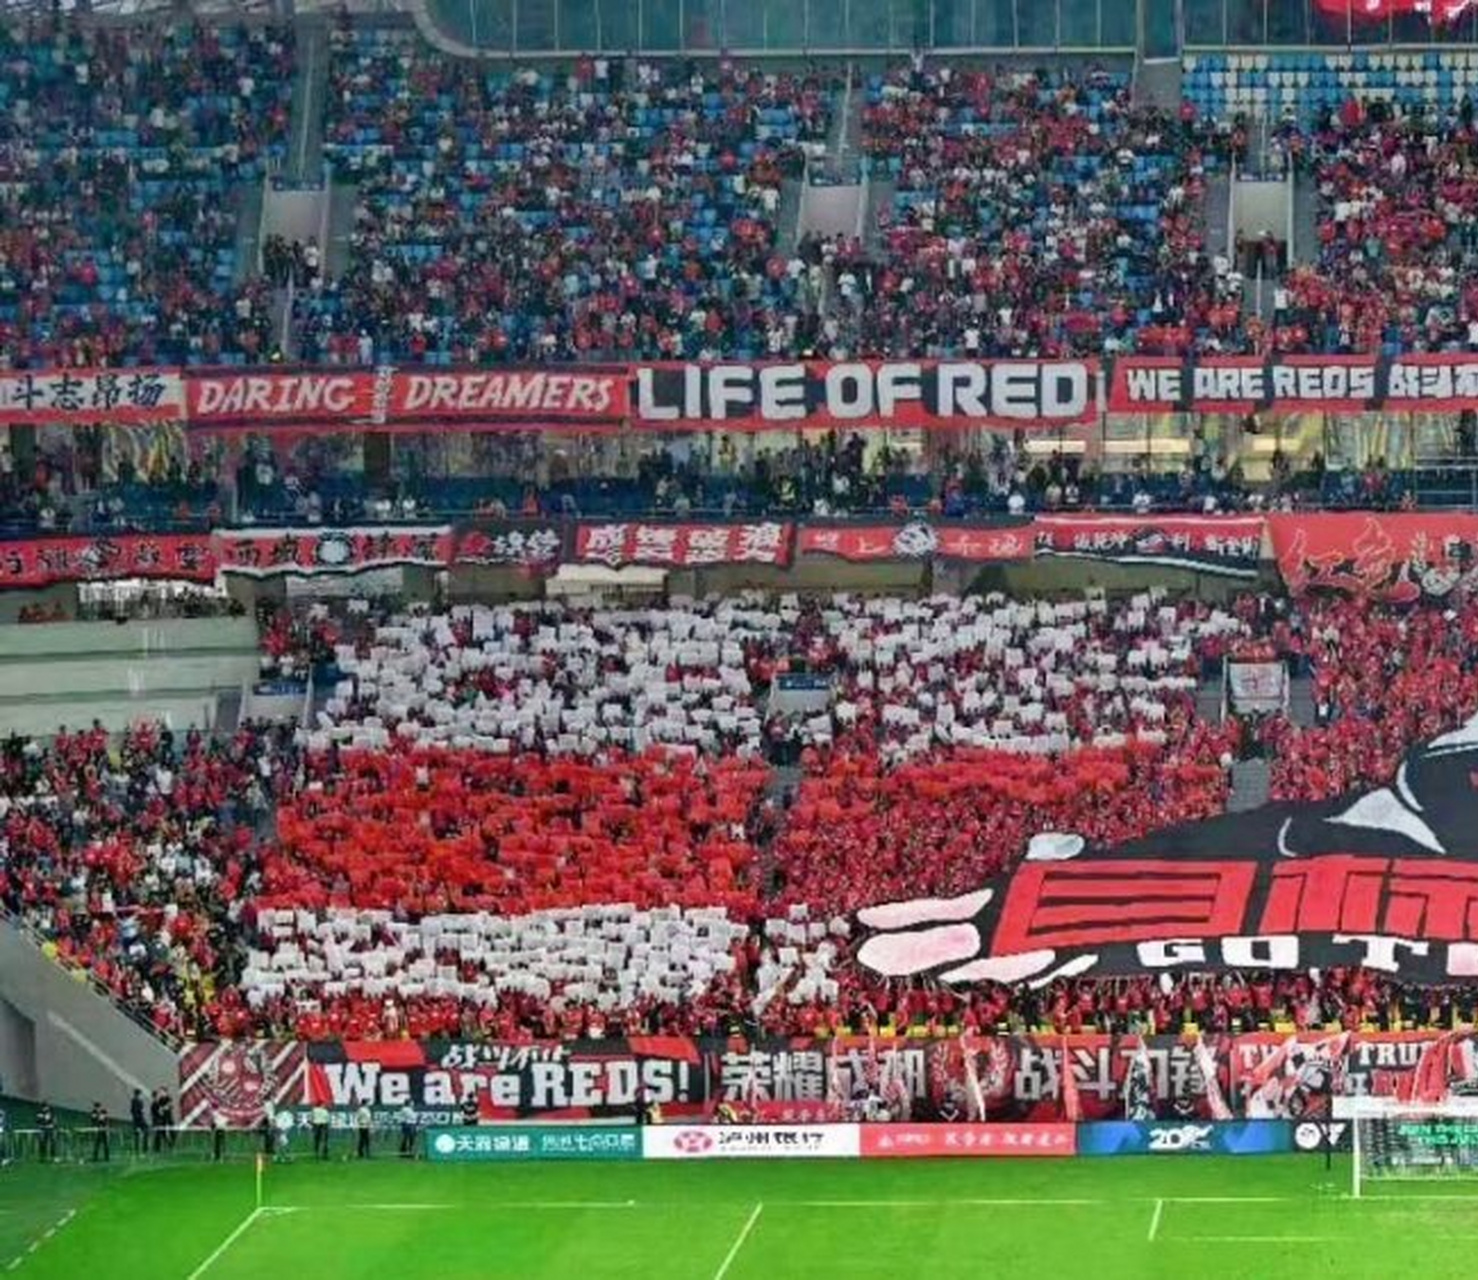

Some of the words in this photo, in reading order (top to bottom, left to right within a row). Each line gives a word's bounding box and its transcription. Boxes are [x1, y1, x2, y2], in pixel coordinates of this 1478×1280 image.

[11, 373, 166, 411] 斗志昂扬
[197, 375, 356, 414] DARING
[405, 372, 612, 412] DREAMERS
[637, 363, 806, 419] LIFE
[824, 363, 923, 419] OF
[937, 362, 1088, 418] RED
[1127, 368, 1182, 400] WE
[1193, 367, 1265, 400] ARE
[1272, 366, 1375, 400] REDS
[1136, 934, 1299, 969] GO
[1358, 1041, 1424, 1065] TRU
[324, 1062, 411, 1105] We
[423, 1071, 521, 1107] are
[530, 1059, 691, 1108] REDS!
